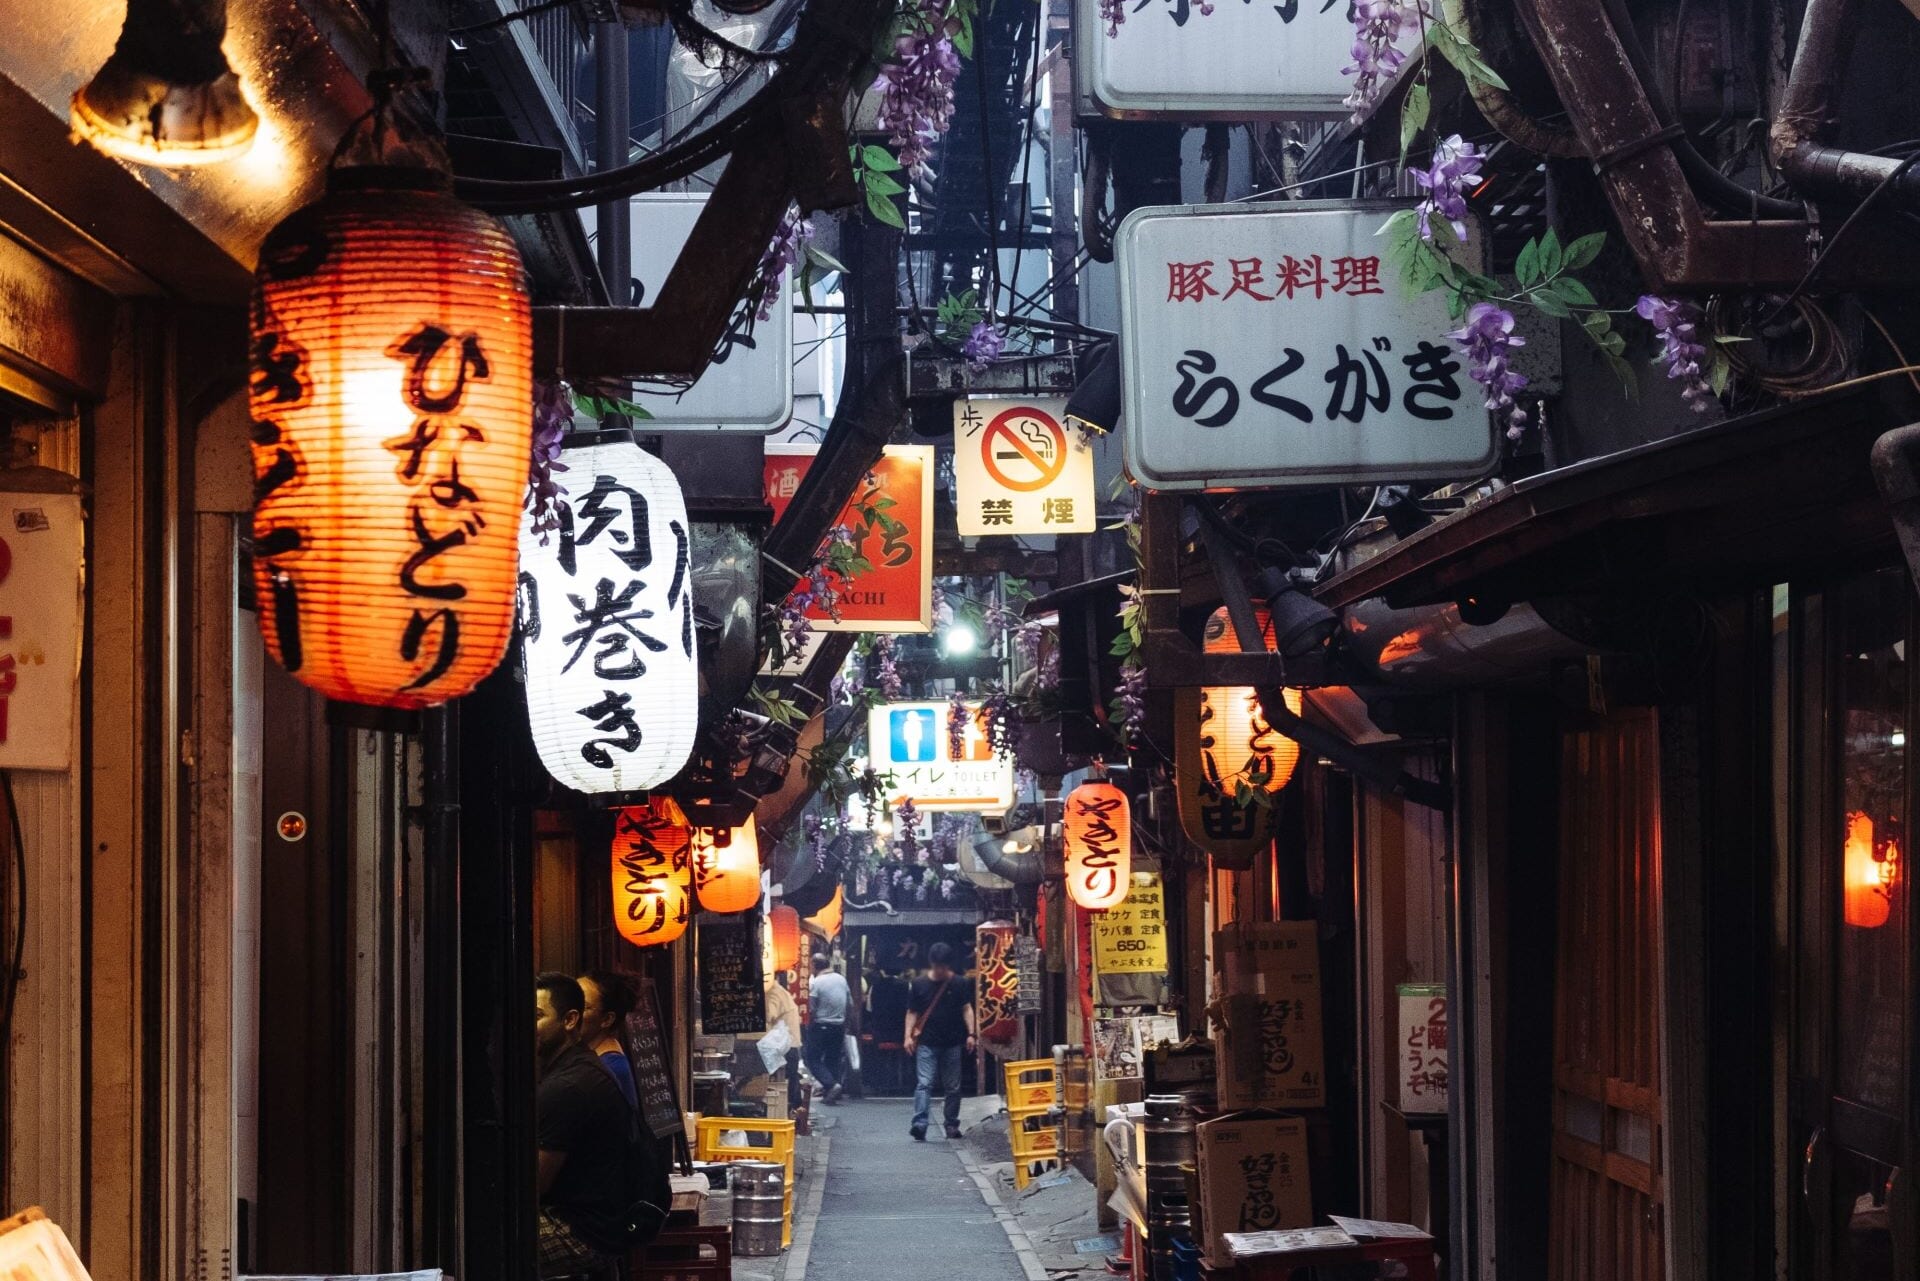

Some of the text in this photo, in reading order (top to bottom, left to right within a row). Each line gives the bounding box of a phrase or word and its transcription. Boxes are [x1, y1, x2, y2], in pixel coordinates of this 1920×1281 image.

[1166, 254, 1384, 303] 豚足料理
[1172, 336, 1462, 428] らくがき
[393, 322, 494, 692] ひなどり
[560, 474, 668, 768] 肉巻き
[878, 767, 998, 784] トイレ TOILET
[1077, 797, 1122, 899] やきとり
[1140, 910, 1160, 920] 定食
[1141, 924, 1161, 936] 定食
[1116, 940, 1146, 952] 650
[1407, 1026, 1426, 1096] どうぞ
